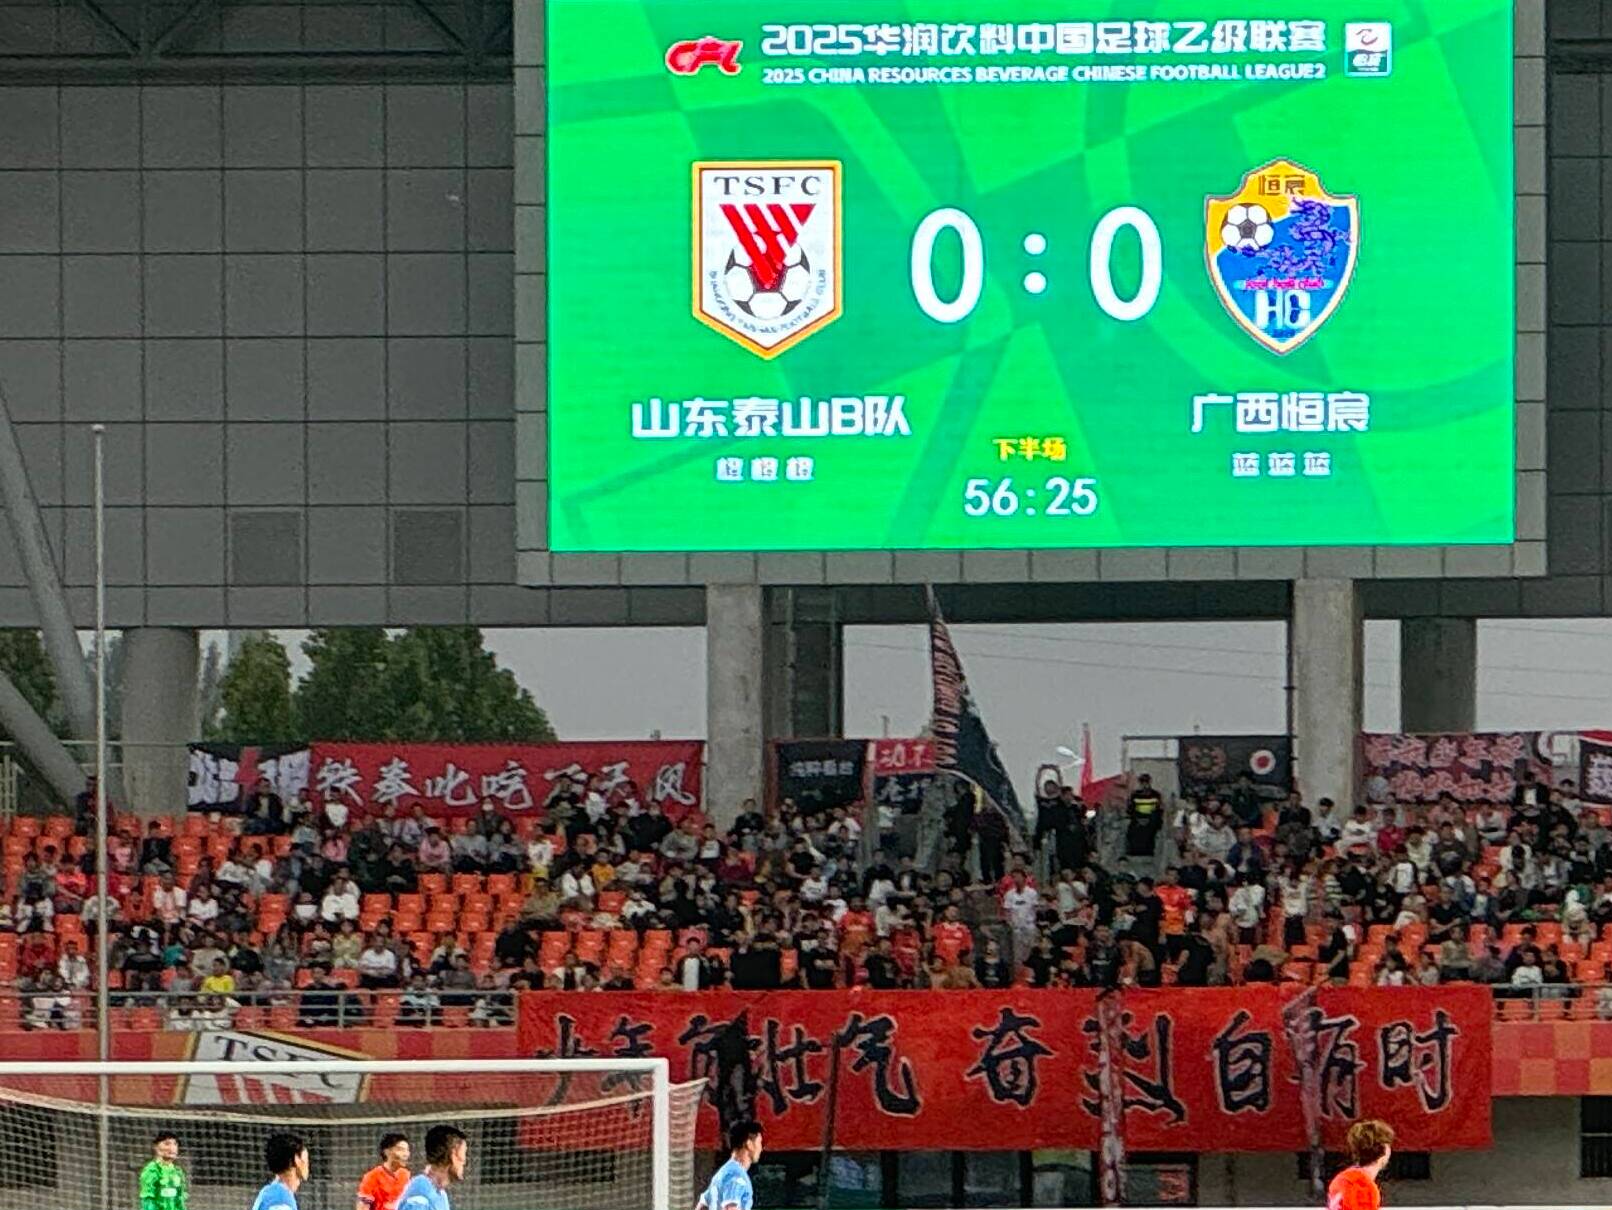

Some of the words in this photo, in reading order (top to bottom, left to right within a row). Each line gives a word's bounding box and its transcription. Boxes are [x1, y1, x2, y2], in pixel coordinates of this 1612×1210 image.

[762, 68, 805, 84] 2025
[808, 67, 865, 84] CHINA
[868, 66, 973, 83] RESOURCES
[975, 65, 1069, 83] BEVERAGE
[1072, 65, 1147, 82] CHINESE
[1150, 64, 1243, 81] FOOTBALL
[713, 175, 822, 196] TSFC
[631, 395, 912, 438] 山东泰山B队
[1190, 391, 1370, 433] 广西恒宸
[993, 436, 1068, 461] 下半场
[964, 477, 1098, 517] 56:25
